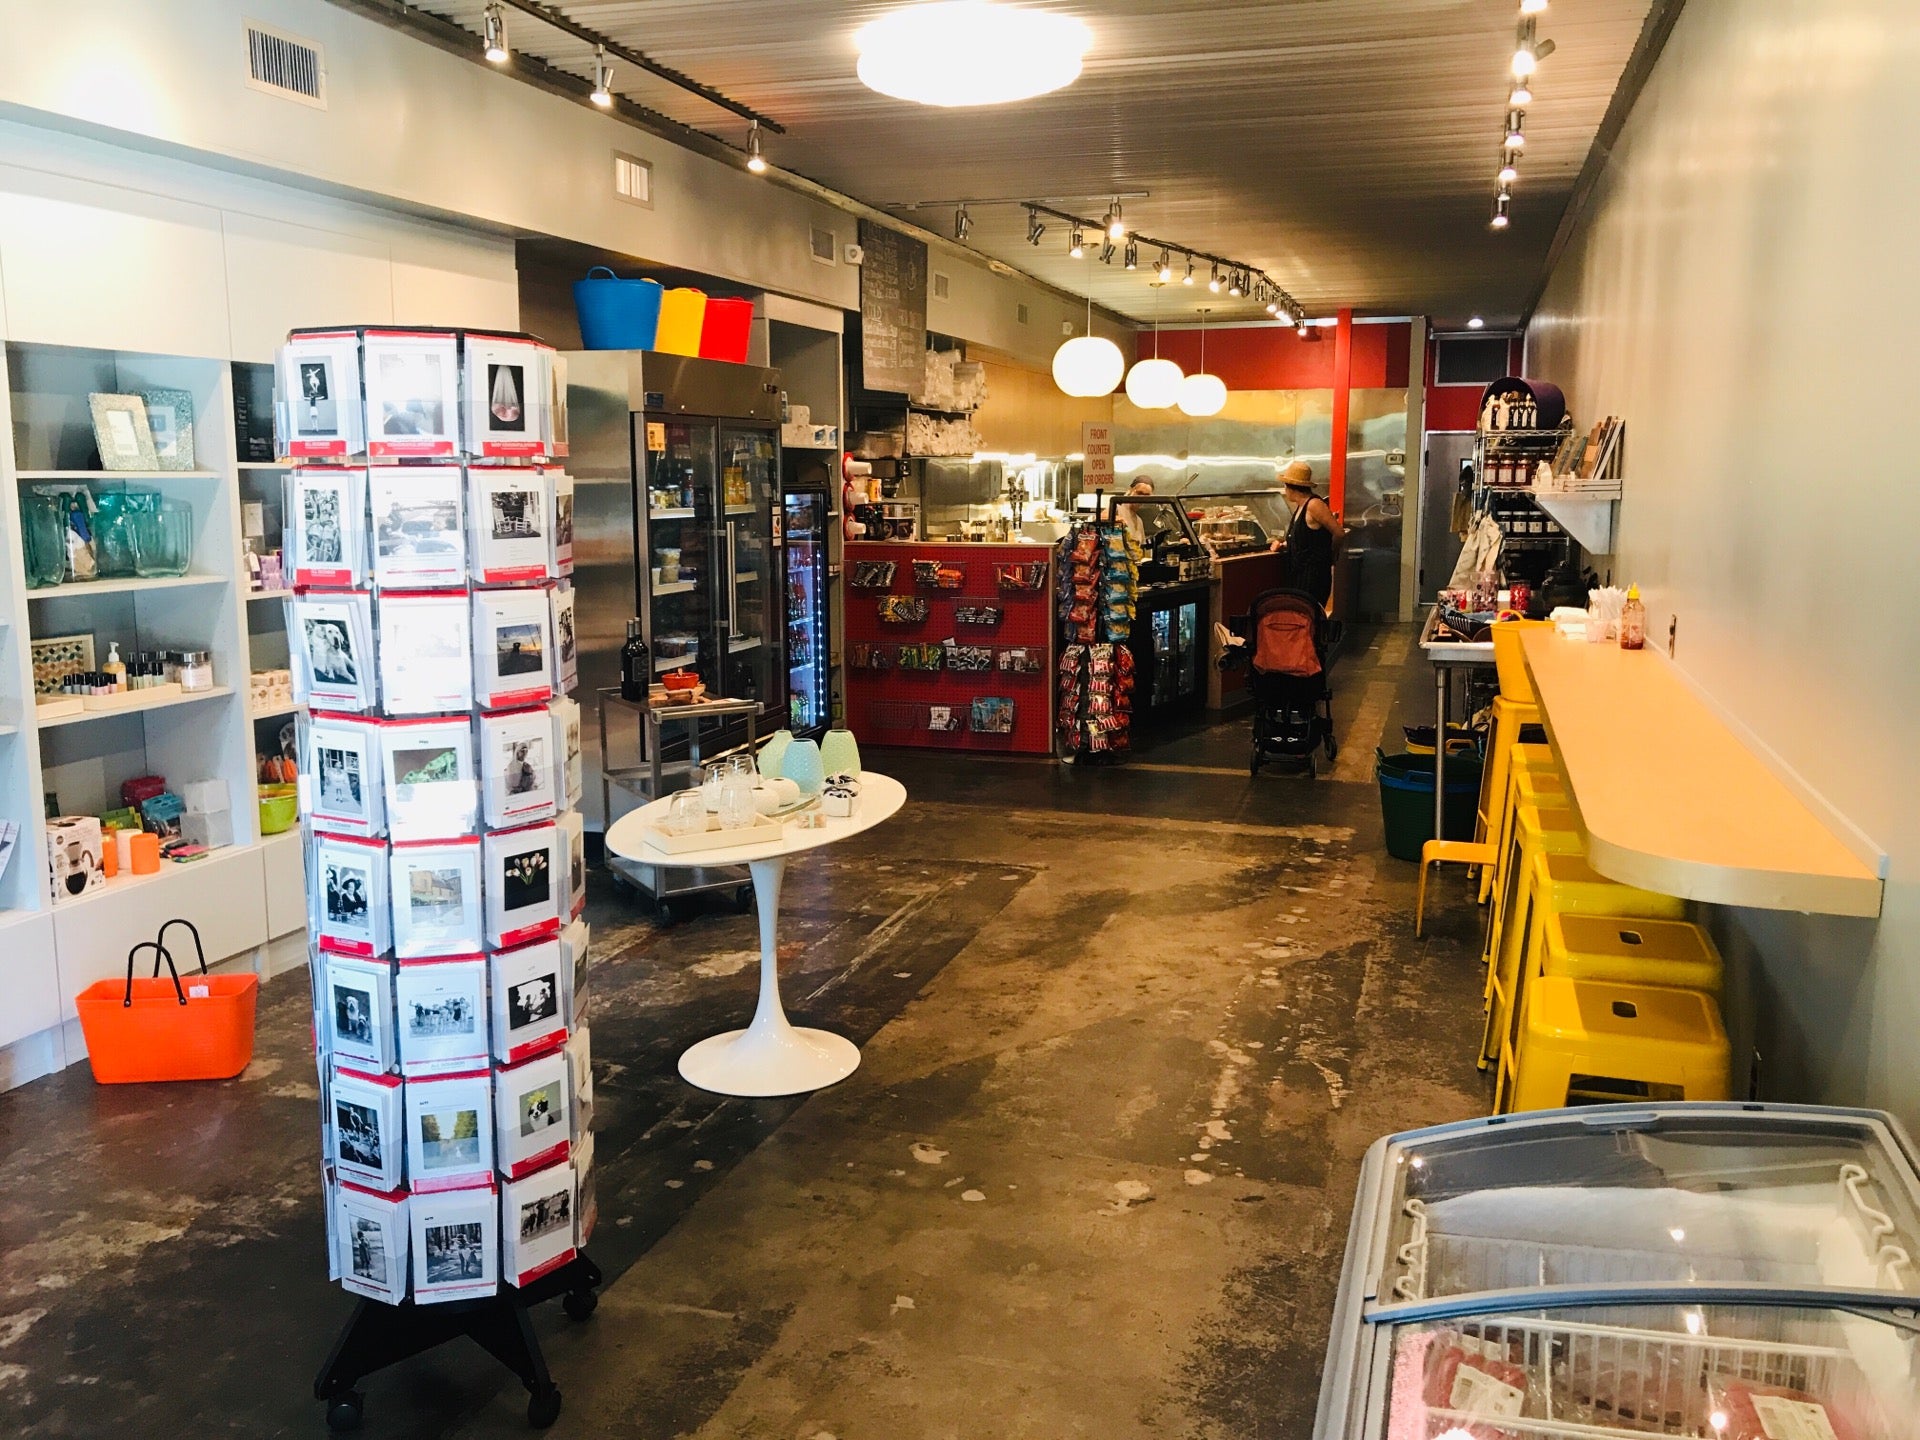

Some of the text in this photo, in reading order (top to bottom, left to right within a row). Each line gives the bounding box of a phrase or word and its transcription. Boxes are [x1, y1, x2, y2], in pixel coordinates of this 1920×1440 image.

[1090, 428, 1107, 440] FRONT
[1087, 444, 1111, 455] COUNTER
[1091, 459, 1106, 470] OPEN
[1084, 473, 1114, 485] FOR ORDERS
